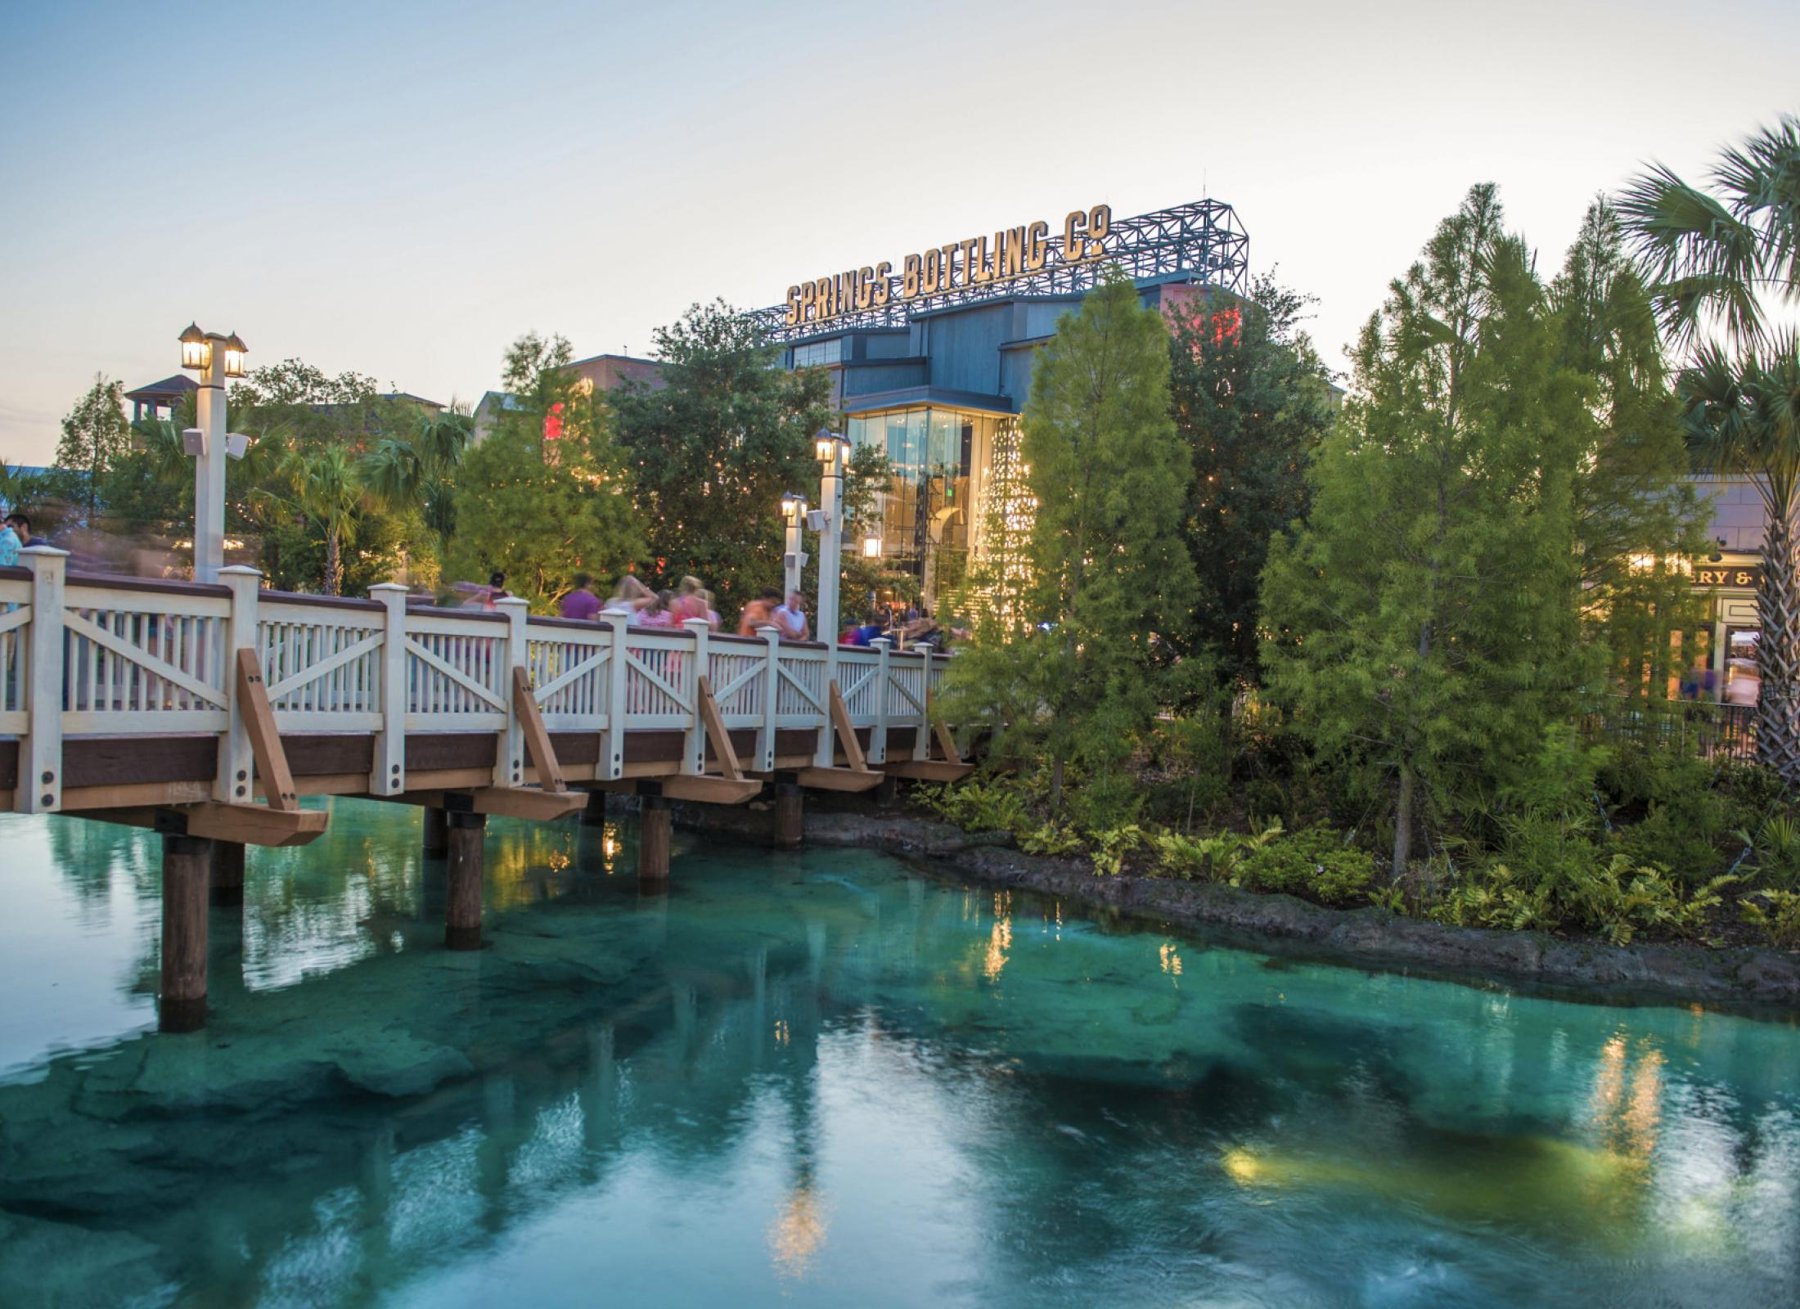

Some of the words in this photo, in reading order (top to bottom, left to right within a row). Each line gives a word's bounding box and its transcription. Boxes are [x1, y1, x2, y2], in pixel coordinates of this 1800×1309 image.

[785, 261, 891, 326] SPRINGS
[902, 220, 1049, 299] BOTTLING
[1736, 571, 1752, 585] &
